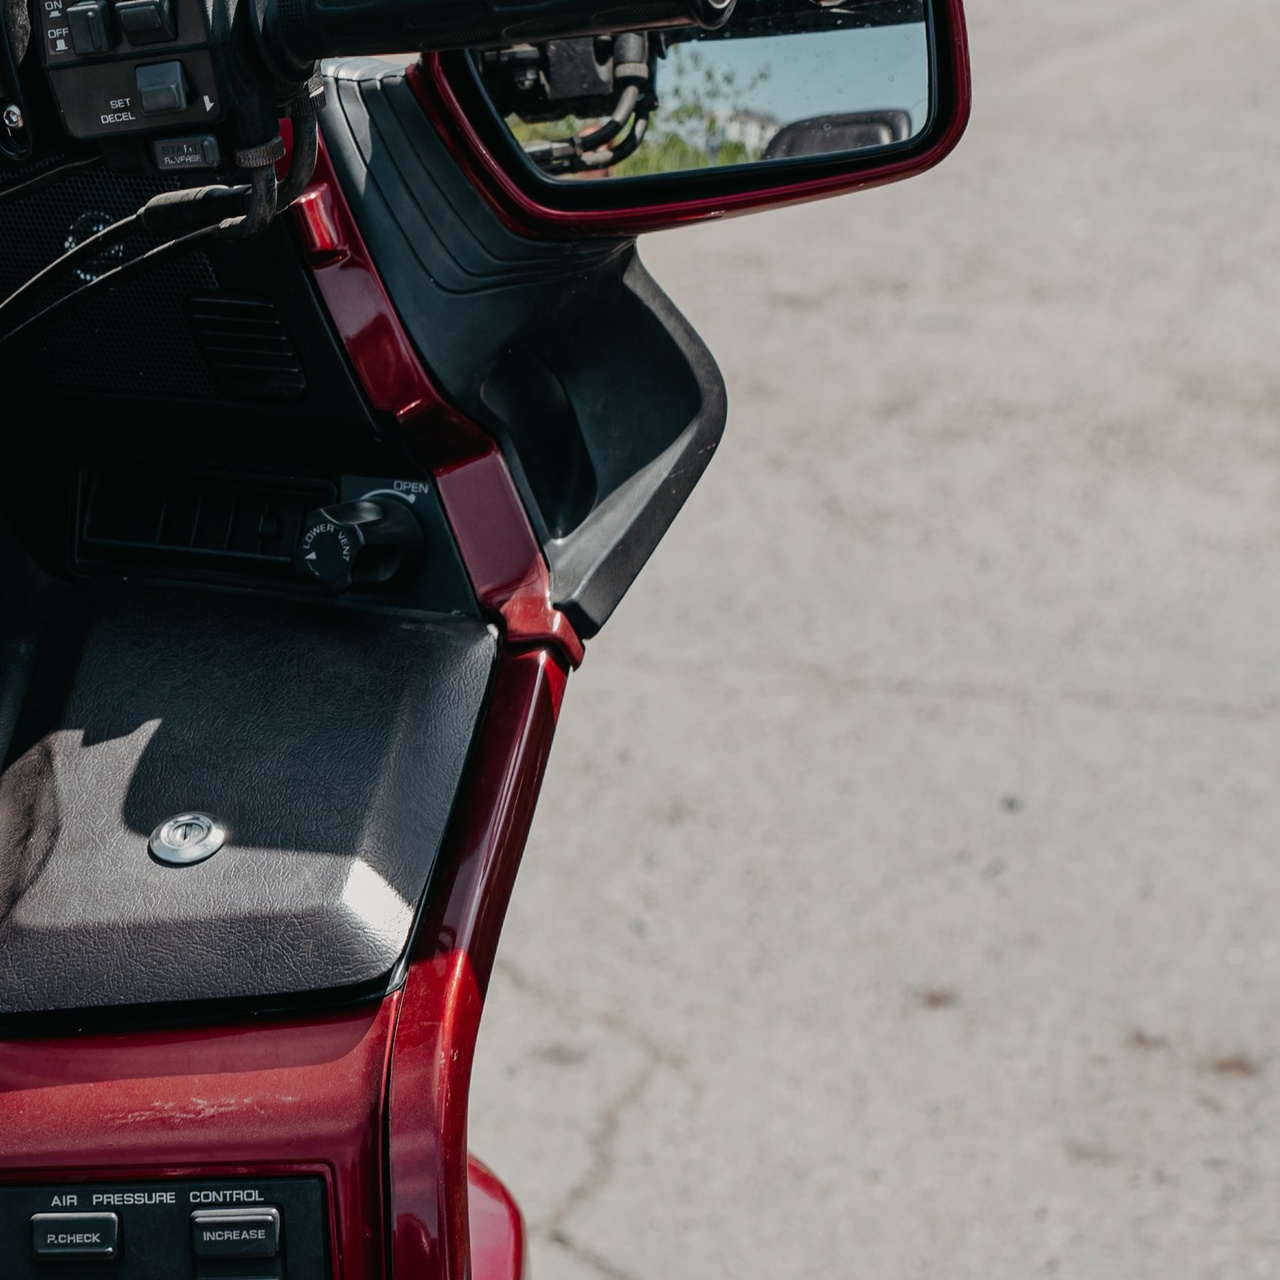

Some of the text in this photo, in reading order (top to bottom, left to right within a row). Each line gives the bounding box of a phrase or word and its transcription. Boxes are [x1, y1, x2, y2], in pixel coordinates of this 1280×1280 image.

[44, 0, 63, 11] ON
[47, 27, 69, 39] OFF
[109, 98, 131, 110] SET
[100, 112, 136, 125] DECEL
[393, 480, 429, 494] OPEN
[303, 523, 350, 562] LOWER VENT
[51, 1189, 264, 1207] AIR PRESSURE CONTROL
[47, 1232, 101, 1244] P.CHECK
[203, 1229, 266, 1242] INCREASE
